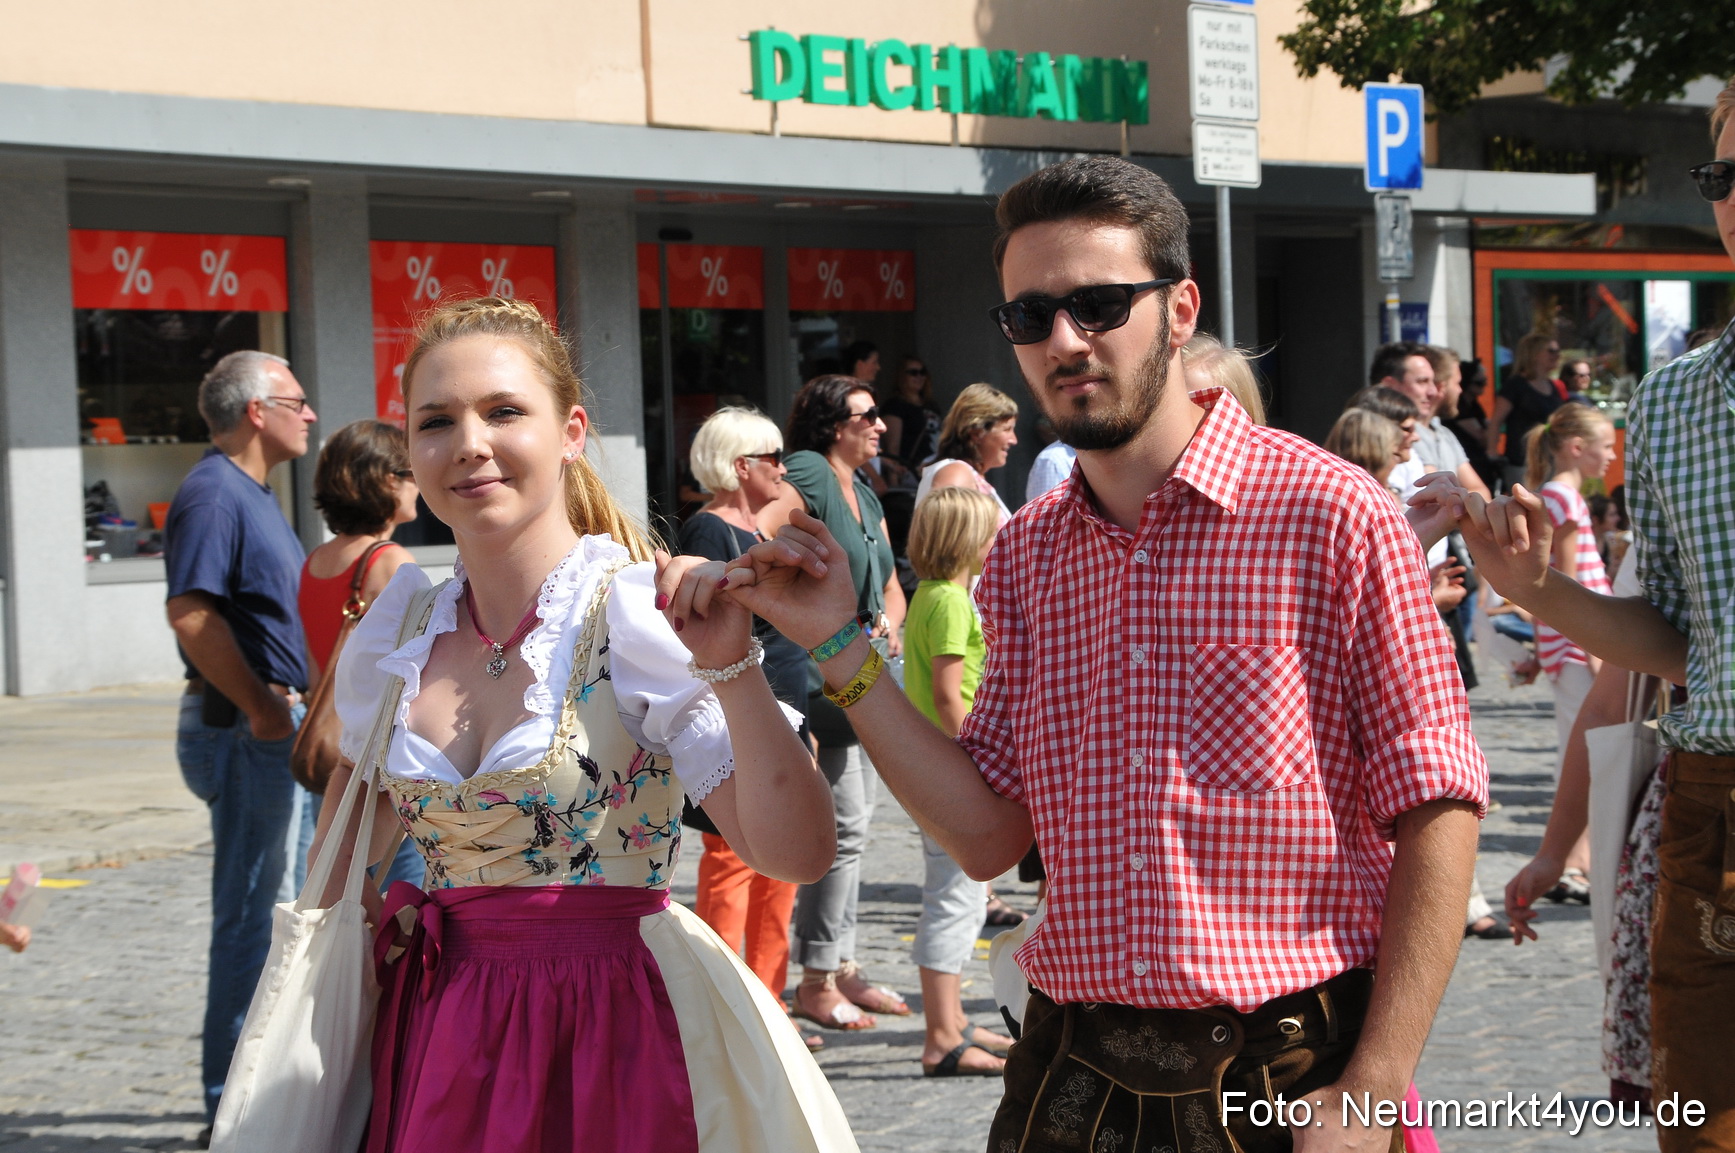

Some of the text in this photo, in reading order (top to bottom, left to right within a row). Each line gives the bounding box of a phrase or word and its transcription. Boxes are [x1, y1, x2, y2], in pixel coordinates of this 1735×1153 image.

[1199, 35, 1252, 54] Parkschein
[1206, 21, 1242, 34] nur mit
[749, 29, 1149, 125] DEICHMANN
[1204, 57, 1247, 75] werktags
[1377, 98, 1410, 177] P
[112, 246, 239, 297] % %
[406, 255, 440, 301] %
[701, 256, 729, 297] %
[818, 260, 905, 300] % %
[844, 681, 867, 703] ROCK
